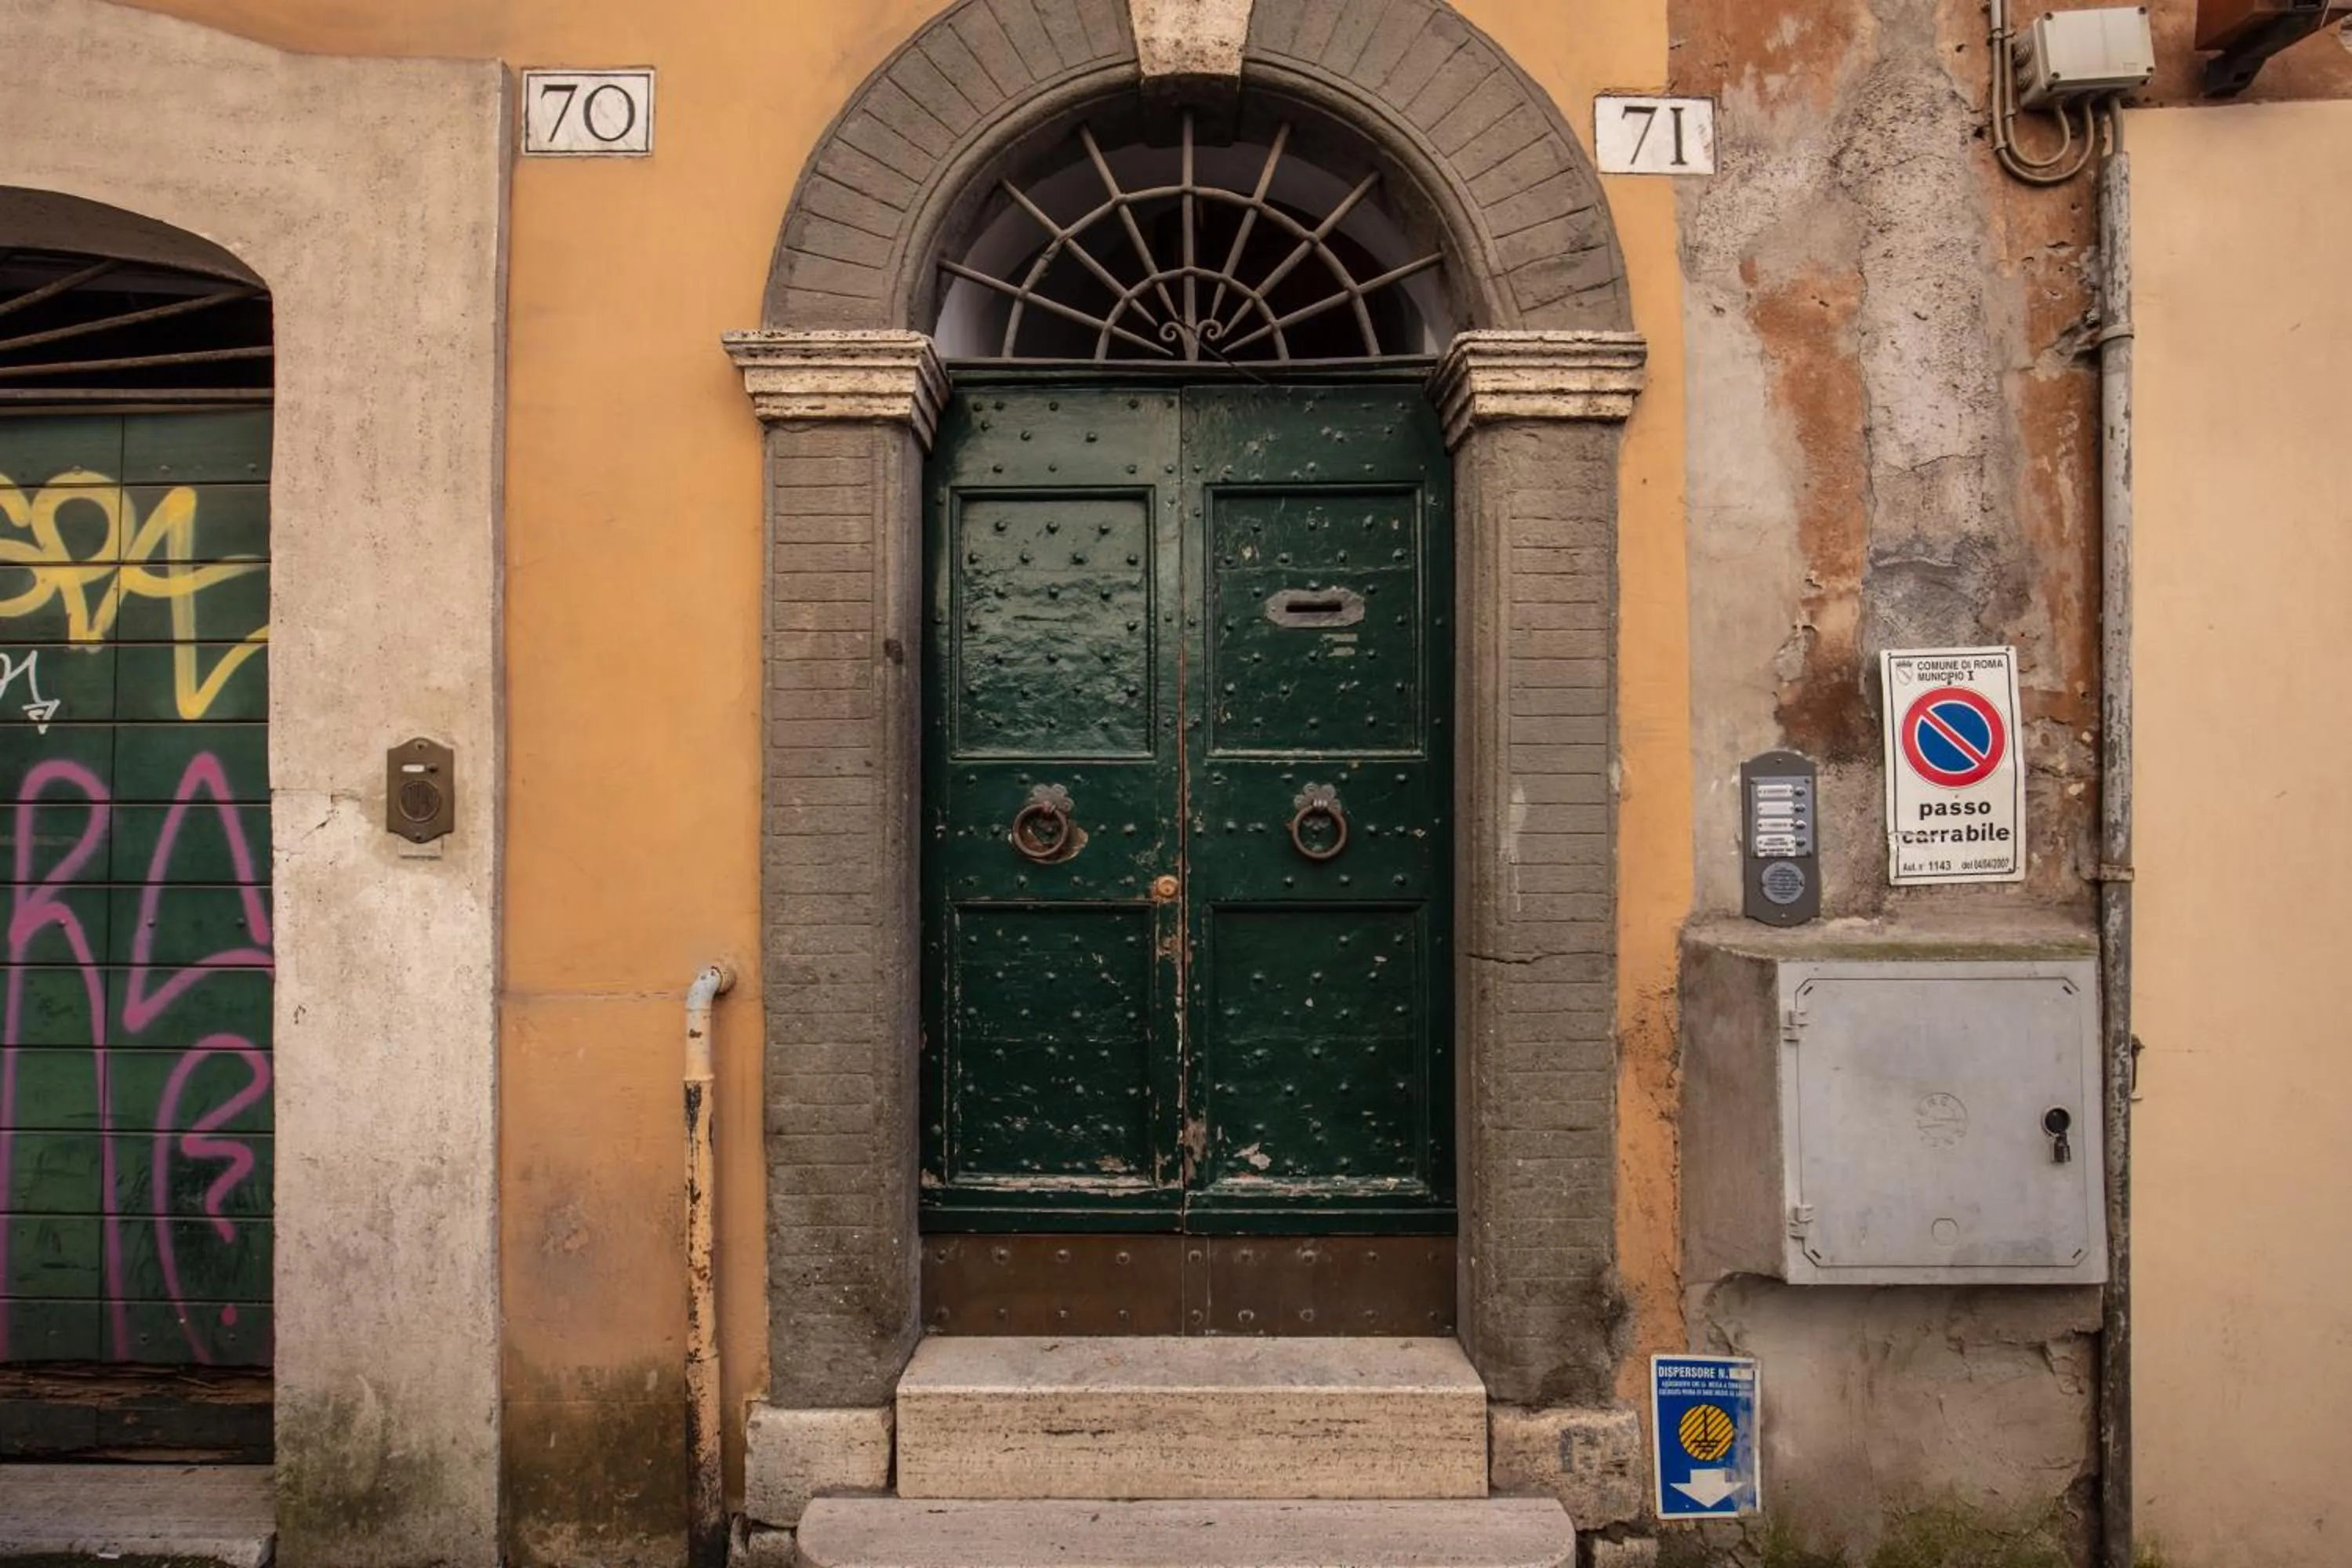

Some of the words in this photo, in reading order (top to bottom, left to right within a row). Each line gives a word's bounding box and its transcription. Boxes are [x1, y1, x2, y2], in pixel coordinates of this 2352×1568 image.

[541, 84, 635, 142] 70
[1917, 660, 1959, 670] COMUNE
[1973, 659, 2003, 669] ROMA
[1918, 671, 1964, 681] MUNICIPIO
[1919, 800, 1991, 820] passo
[1903, 822, 2010, 844] carrabile
[1929, 860, 1951, 871] 1143
[1658, 1367, 1715, 1378] DISPERSORE
